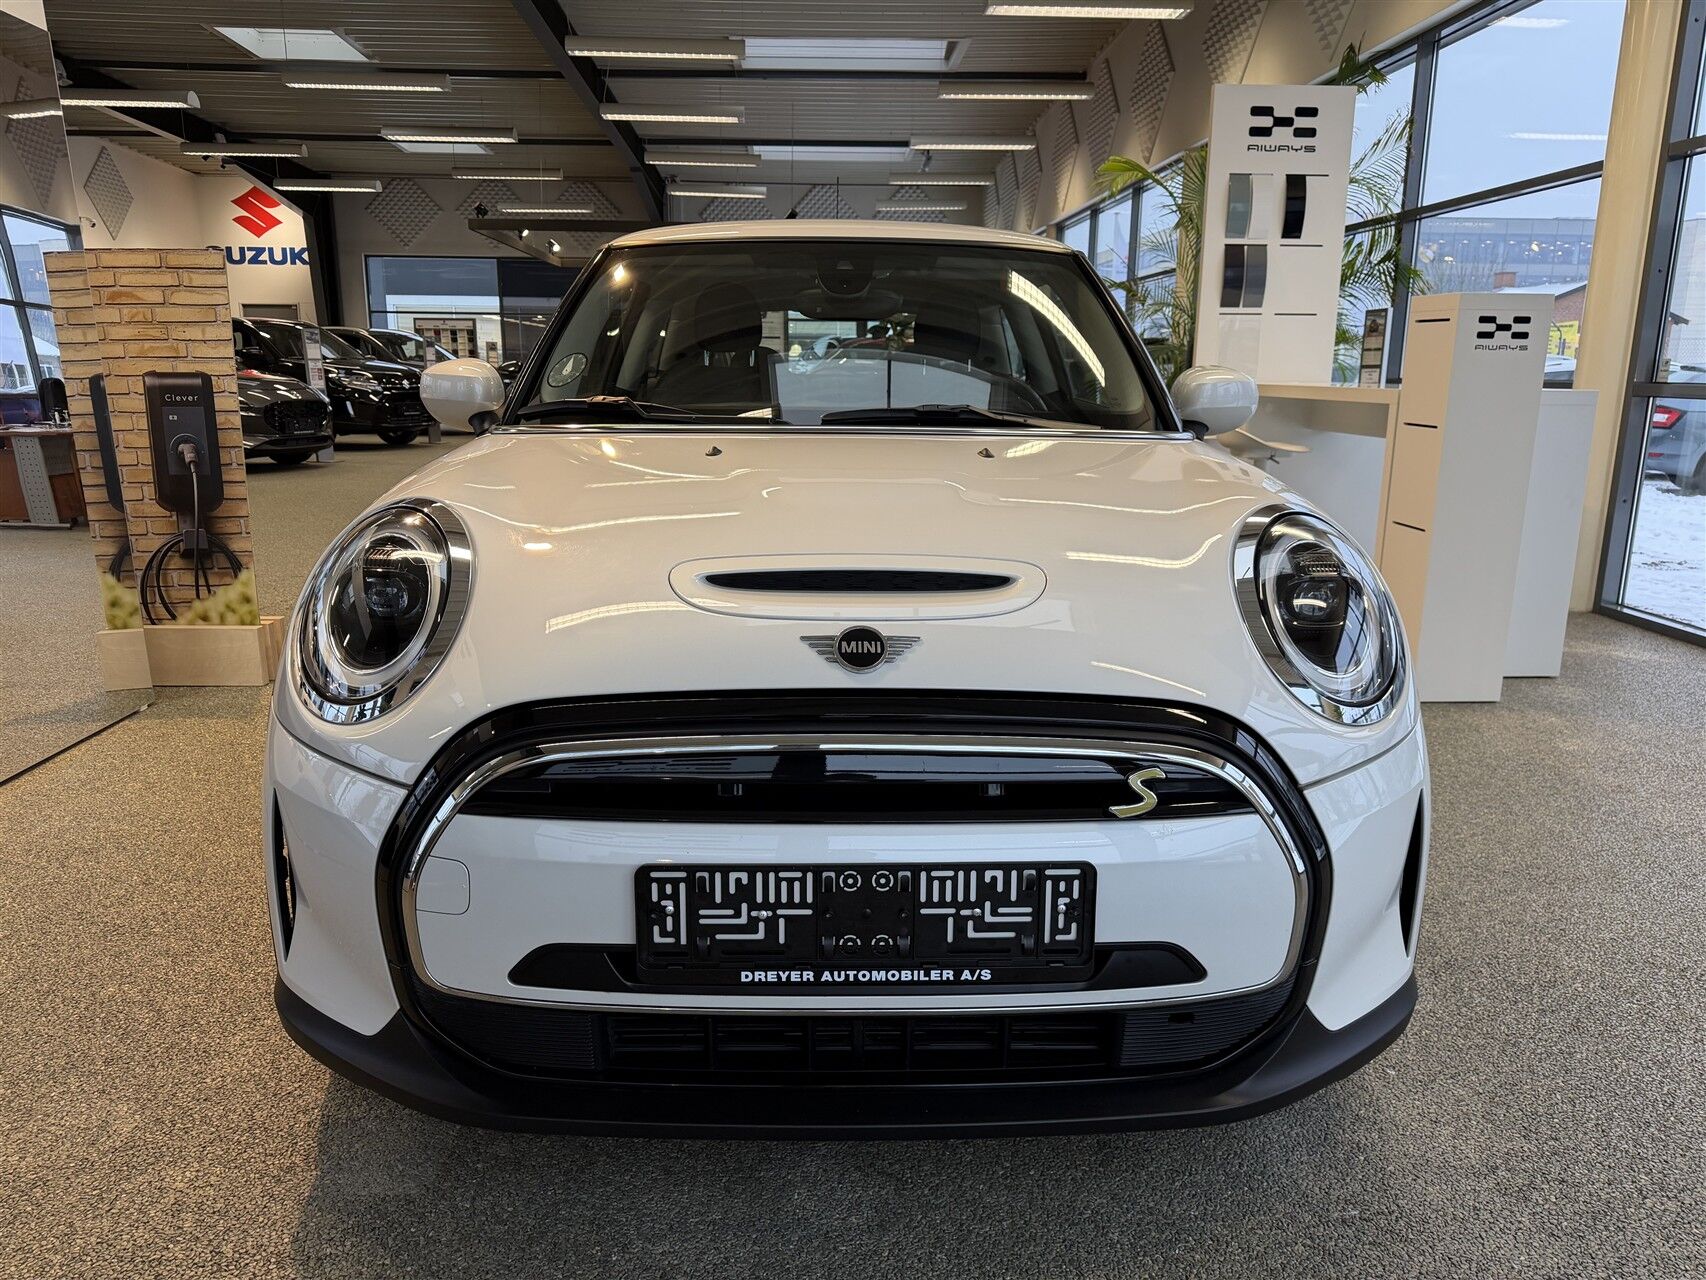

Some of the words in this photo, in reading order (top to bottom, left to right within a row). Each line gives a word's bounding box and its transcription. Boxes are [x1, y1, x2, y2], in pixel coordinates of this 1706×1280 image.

[1247, 144, 1316, 153] AIWAYS
[206, 245, 309, 266] UZUK
[164, 394, 199, 402] Clever
[841, 641, 881, 654] MINI
[1109, 767, 1167, 818] S
[740, 971, 815, 982] DREYER
[820, 970, 955, 982] AUTOMOBILER
[960, 969, 992, 981] A/S
